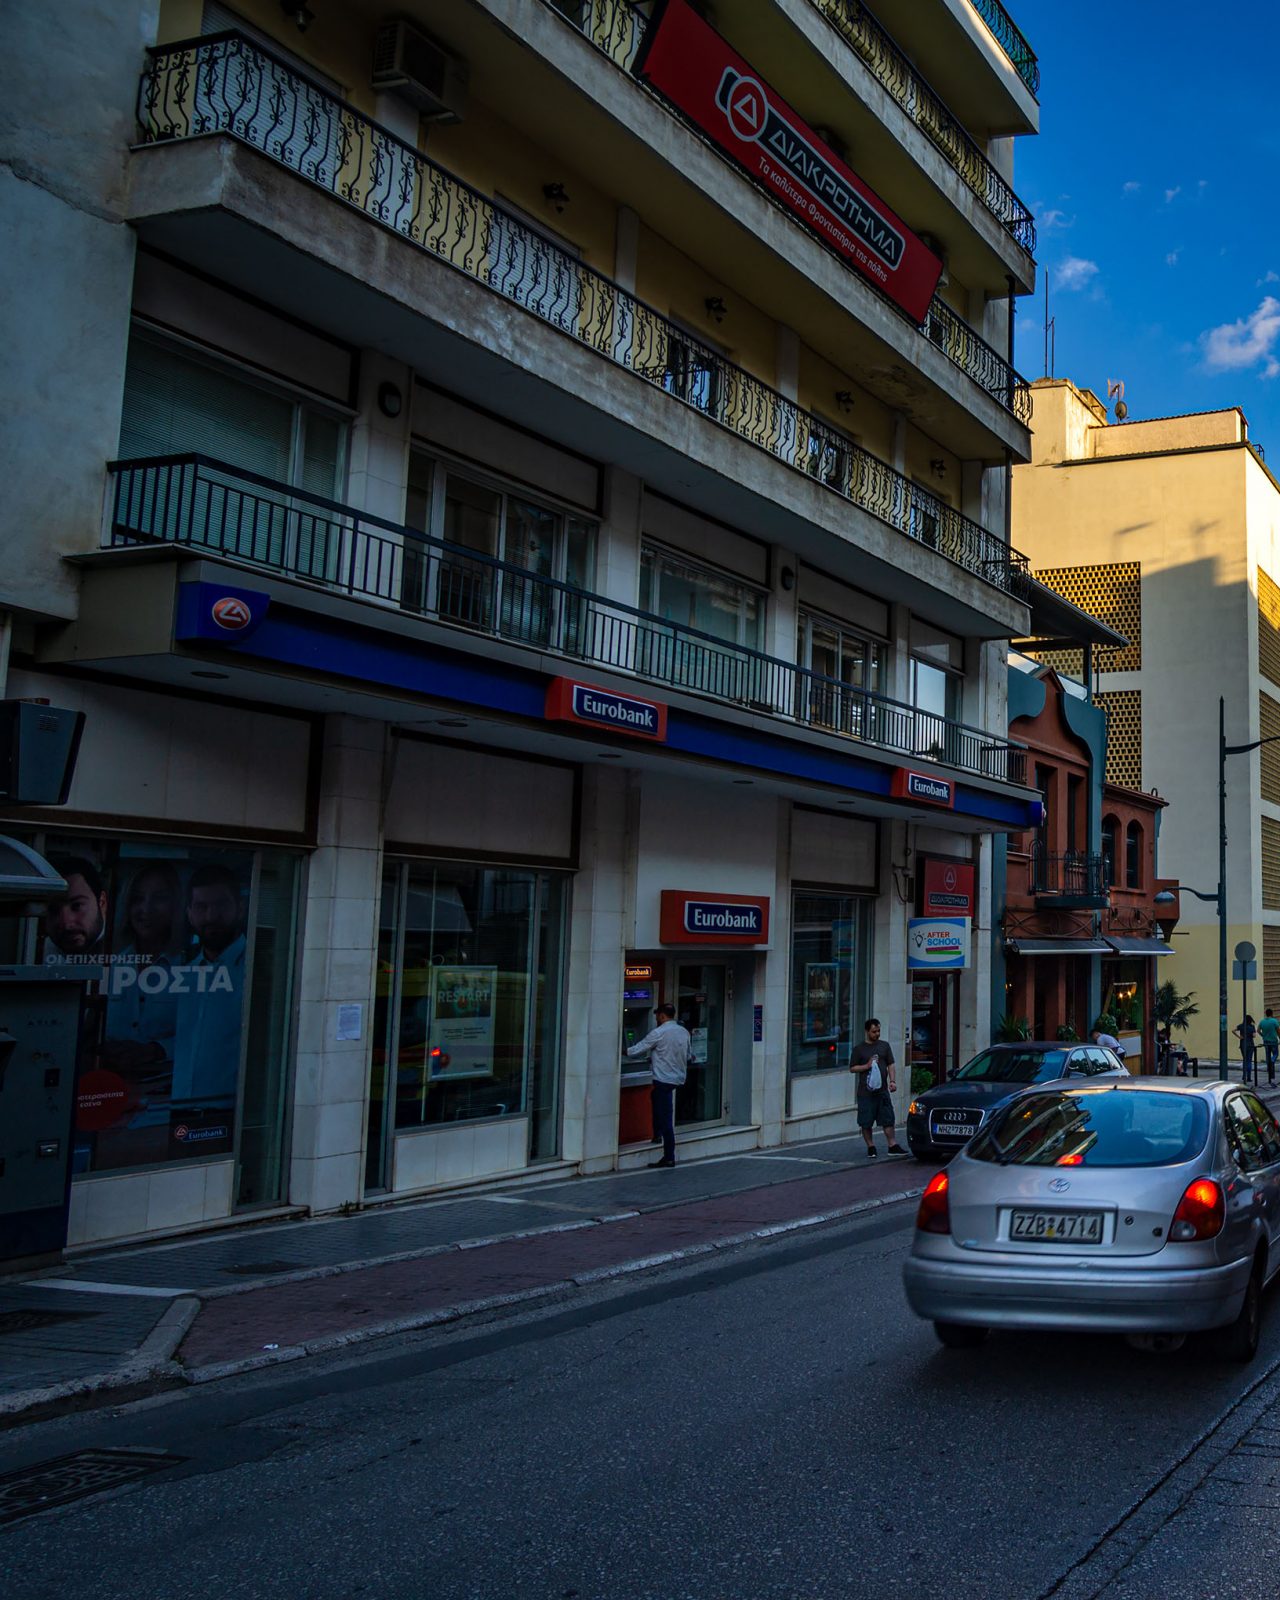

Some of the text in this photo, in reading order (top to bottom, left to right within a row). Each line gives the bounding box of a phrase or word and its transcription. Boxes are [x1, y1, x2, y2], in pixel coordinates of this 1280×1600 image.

[768, 129, 896, 260] ΔΙΑΚΡΟΤΗΜΑ
[583, 694, 653, 728] Eurobank
[914, 779, 949, 799] Eurobank
[694, 908, 757, 929] Eurobank
[927, 931, 950, 939] AFTER
[927, 937, 962, 947] SCHOOL
[64, 953, 153, 965] ΕΠΙΧΕΙΡΗΣΕΙΣ
[626, 968, 650, 976] Eurobank
[437, 990, 490, 1004] RESTART
[189, 1128, 224, 1140] Eurobank
